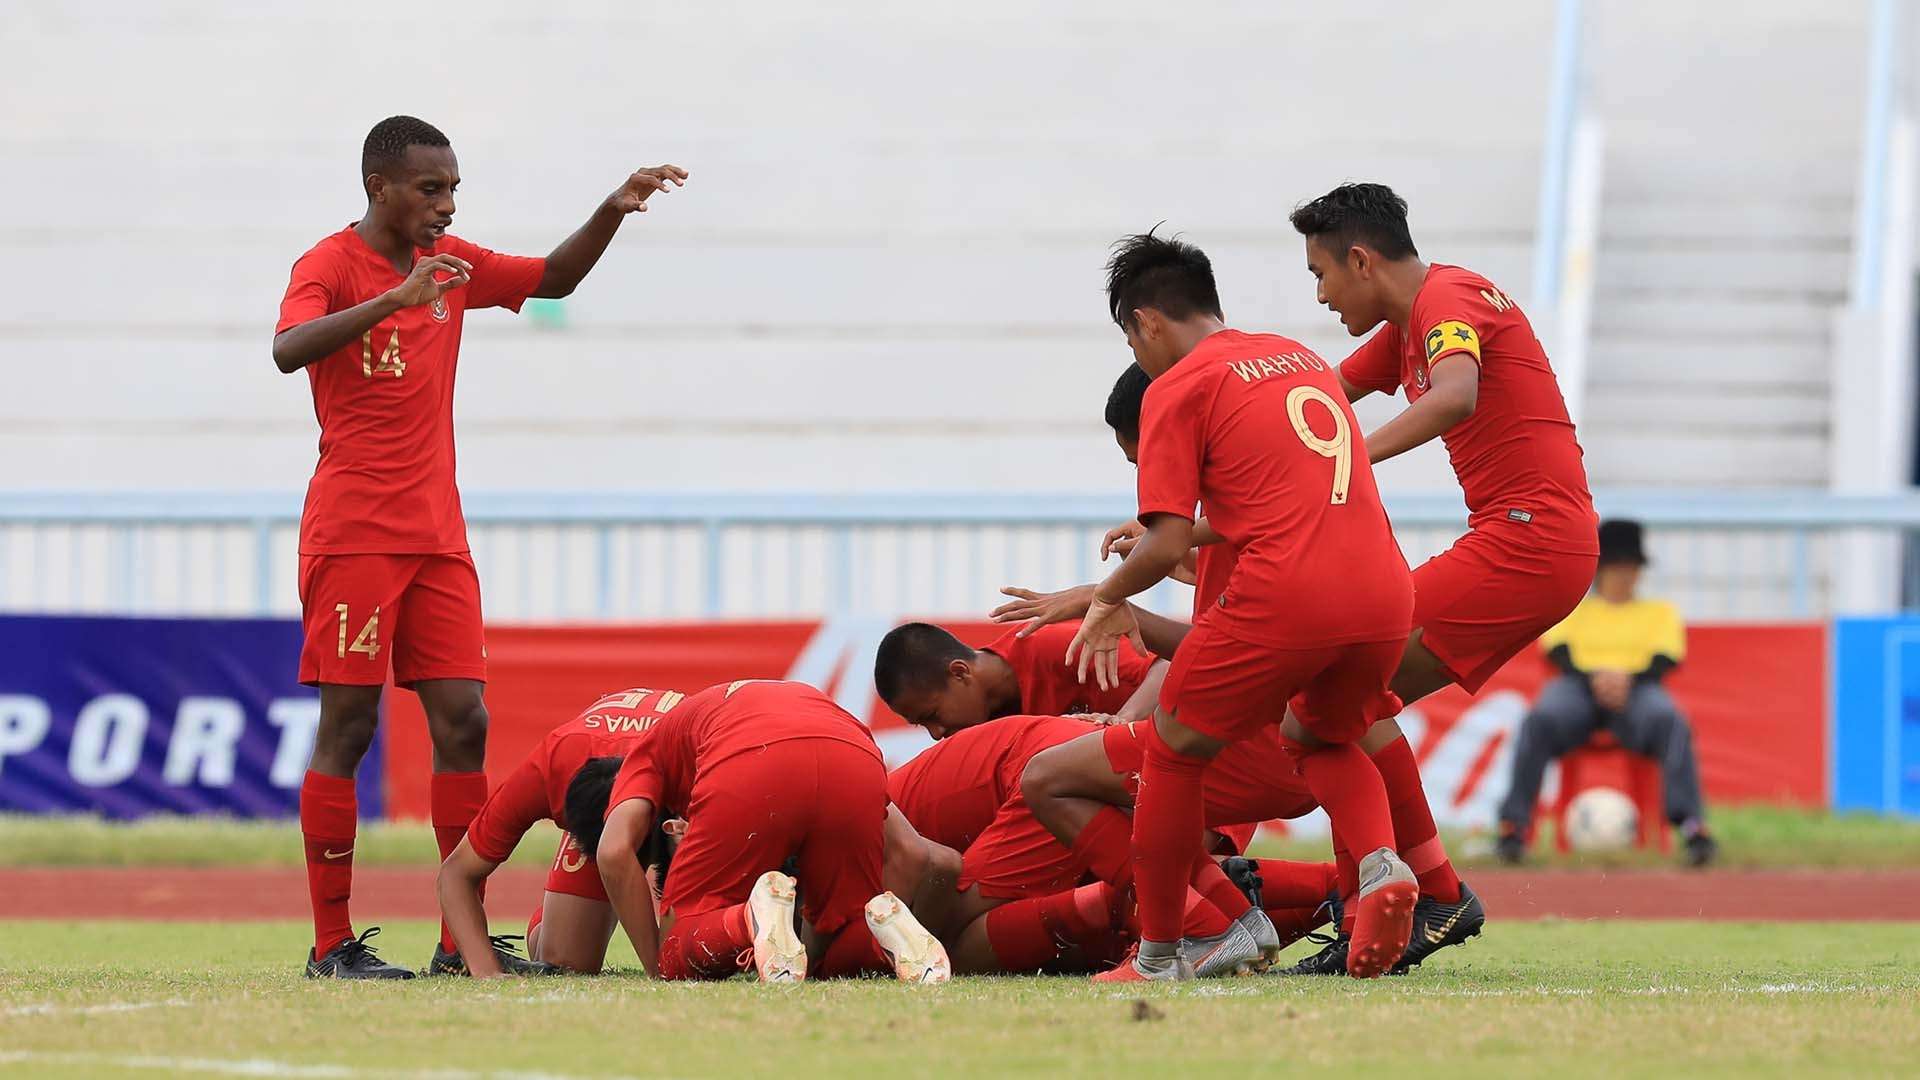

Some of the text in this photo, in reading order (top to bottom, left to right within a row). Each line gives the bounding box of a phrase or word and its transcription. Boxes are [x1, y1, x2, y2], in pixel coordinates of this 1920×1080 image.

[361, 325, 407, 378] 14
[1227, 351, 1326, 383] WAHYU
[1285, 385, 1352, 505] 9
[335, 603, 382, 661] 14
[584, 714, 660, 733] IMAS
